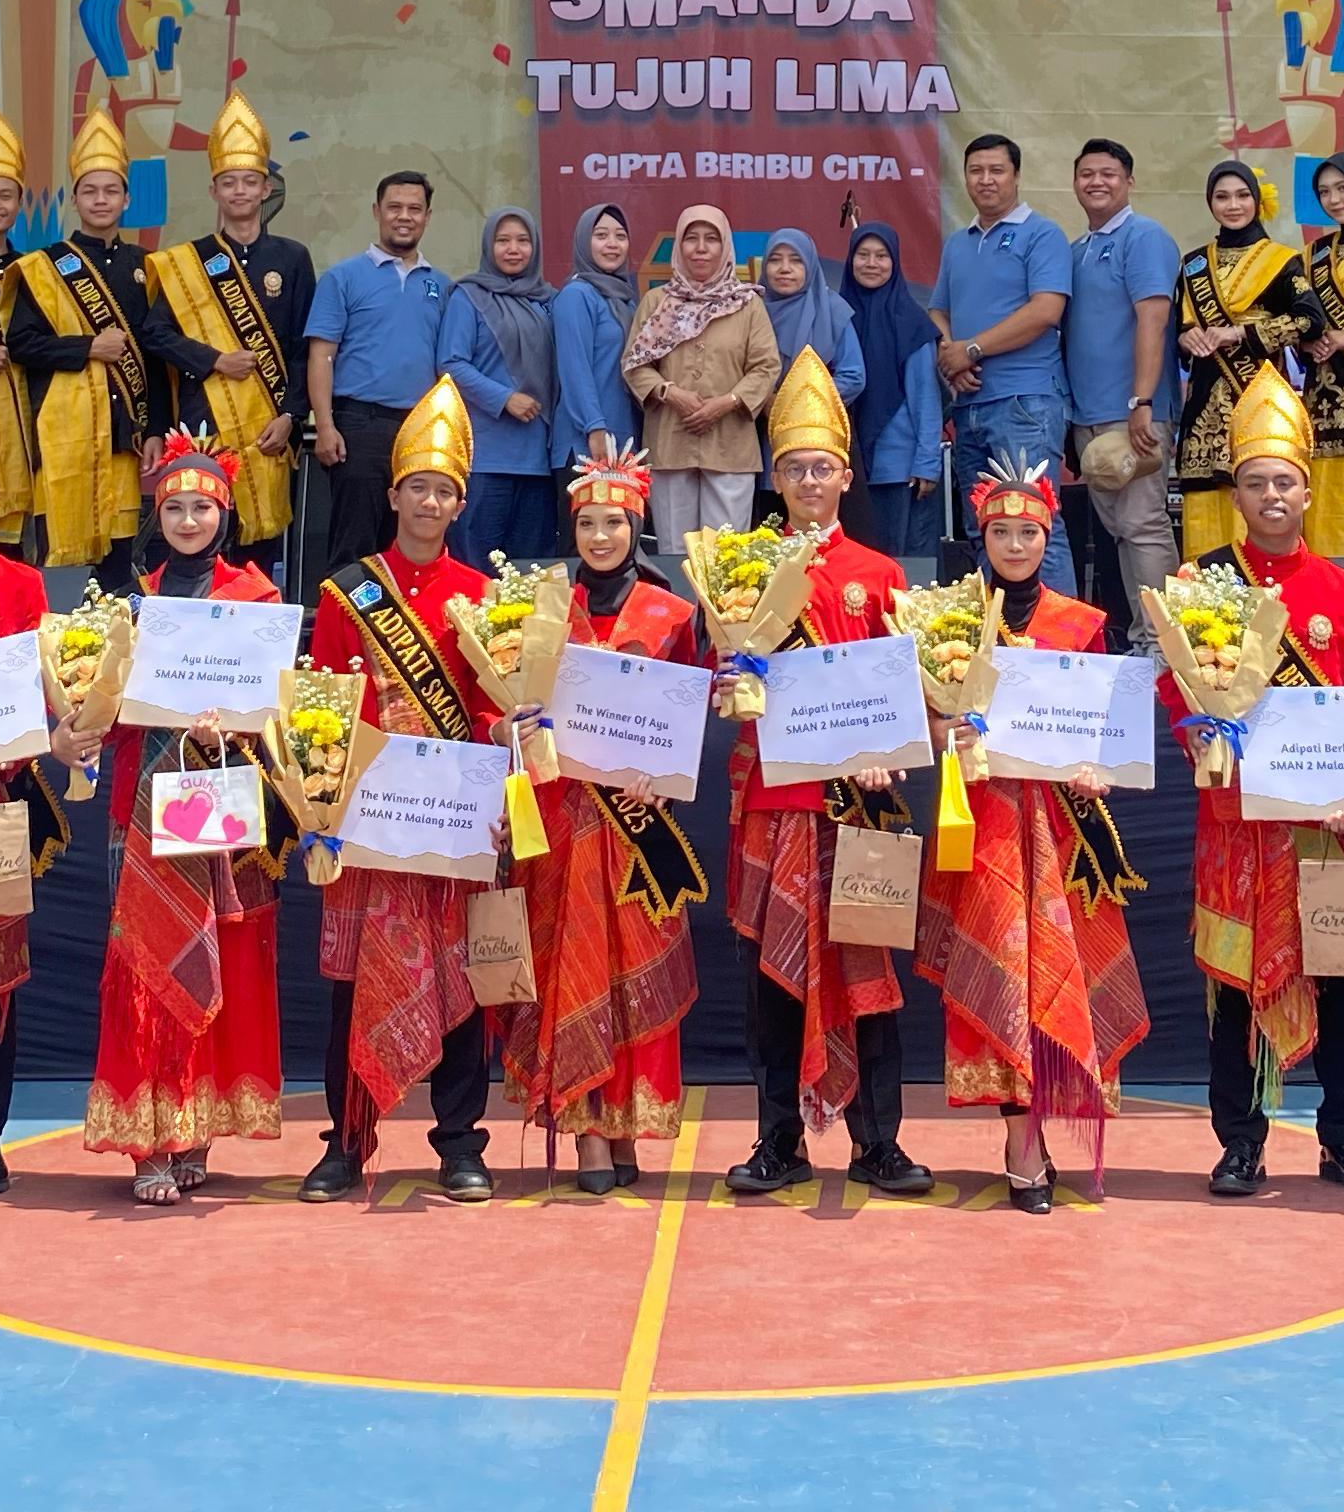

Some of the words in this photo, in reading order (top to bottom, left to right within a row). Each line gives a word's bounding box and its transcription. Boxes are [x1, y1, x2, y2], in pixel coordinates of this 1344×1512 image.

[525, 56, 753, 112] TUJUH
[774, 56, 961, 114] LIMA
[582, 152, 688, 178] CIPTA
[695, 153, 813, 179] BERIBU
[822, 154, 903, 181] CITA
[71, 276, 112, 325] ADIPATI
[218, 278, 258, 332] ADIPATI
[244, 331, 282, 389] SMANDA
[369, 605, 434, 682] ADIPATI
[181, 653, 201, 668] Ayu
[204, 653, 242, 667] Literasi
[575, 702, 594, 716] The
[594, 706, 633, 724] Winner
[634, 714, 647, 727] Of
[648, 716, 670, 733] Ayu
[790, 701, 829, 720] Adipati
[830, 694, 889, 715] Intelegensi
[1026, 703, 1048, 719] Ayu
[1050, 706, 1110, 722] Intelegensi
[785, 721, 819, 735] SMAN
[820, 720, 827, 731] 2
[829, 714, 870, 731] Malang
[871, 711, 898, 725] 2025
[1010, 719, 1043, 732] SMAN
[1045, 722, 1053, 733] 2
[1055, 723, 1097, 739] Malang
[1099, 726, 1126, 739] 2025
[1280, 742, 1321, 758] Adipati
[1269, 759, 1303, 771] SMAN
[1306, 760, 1313, 771] 2
[360, 788, 378, 801] The
[381, 791, 420, 805] Winner
[422, 795, 436, 808] Of
[438, 796, 478, 813] Adipati
[609, 785, 656, 834] 2025
[359, 808, 393, 821] SMAN
[395, 811, 402, 822] 2
[404, 811, 445, 829] Malang
[447, 816, 474, 830] 2025
[838, 874, 913, 900] Caroline
